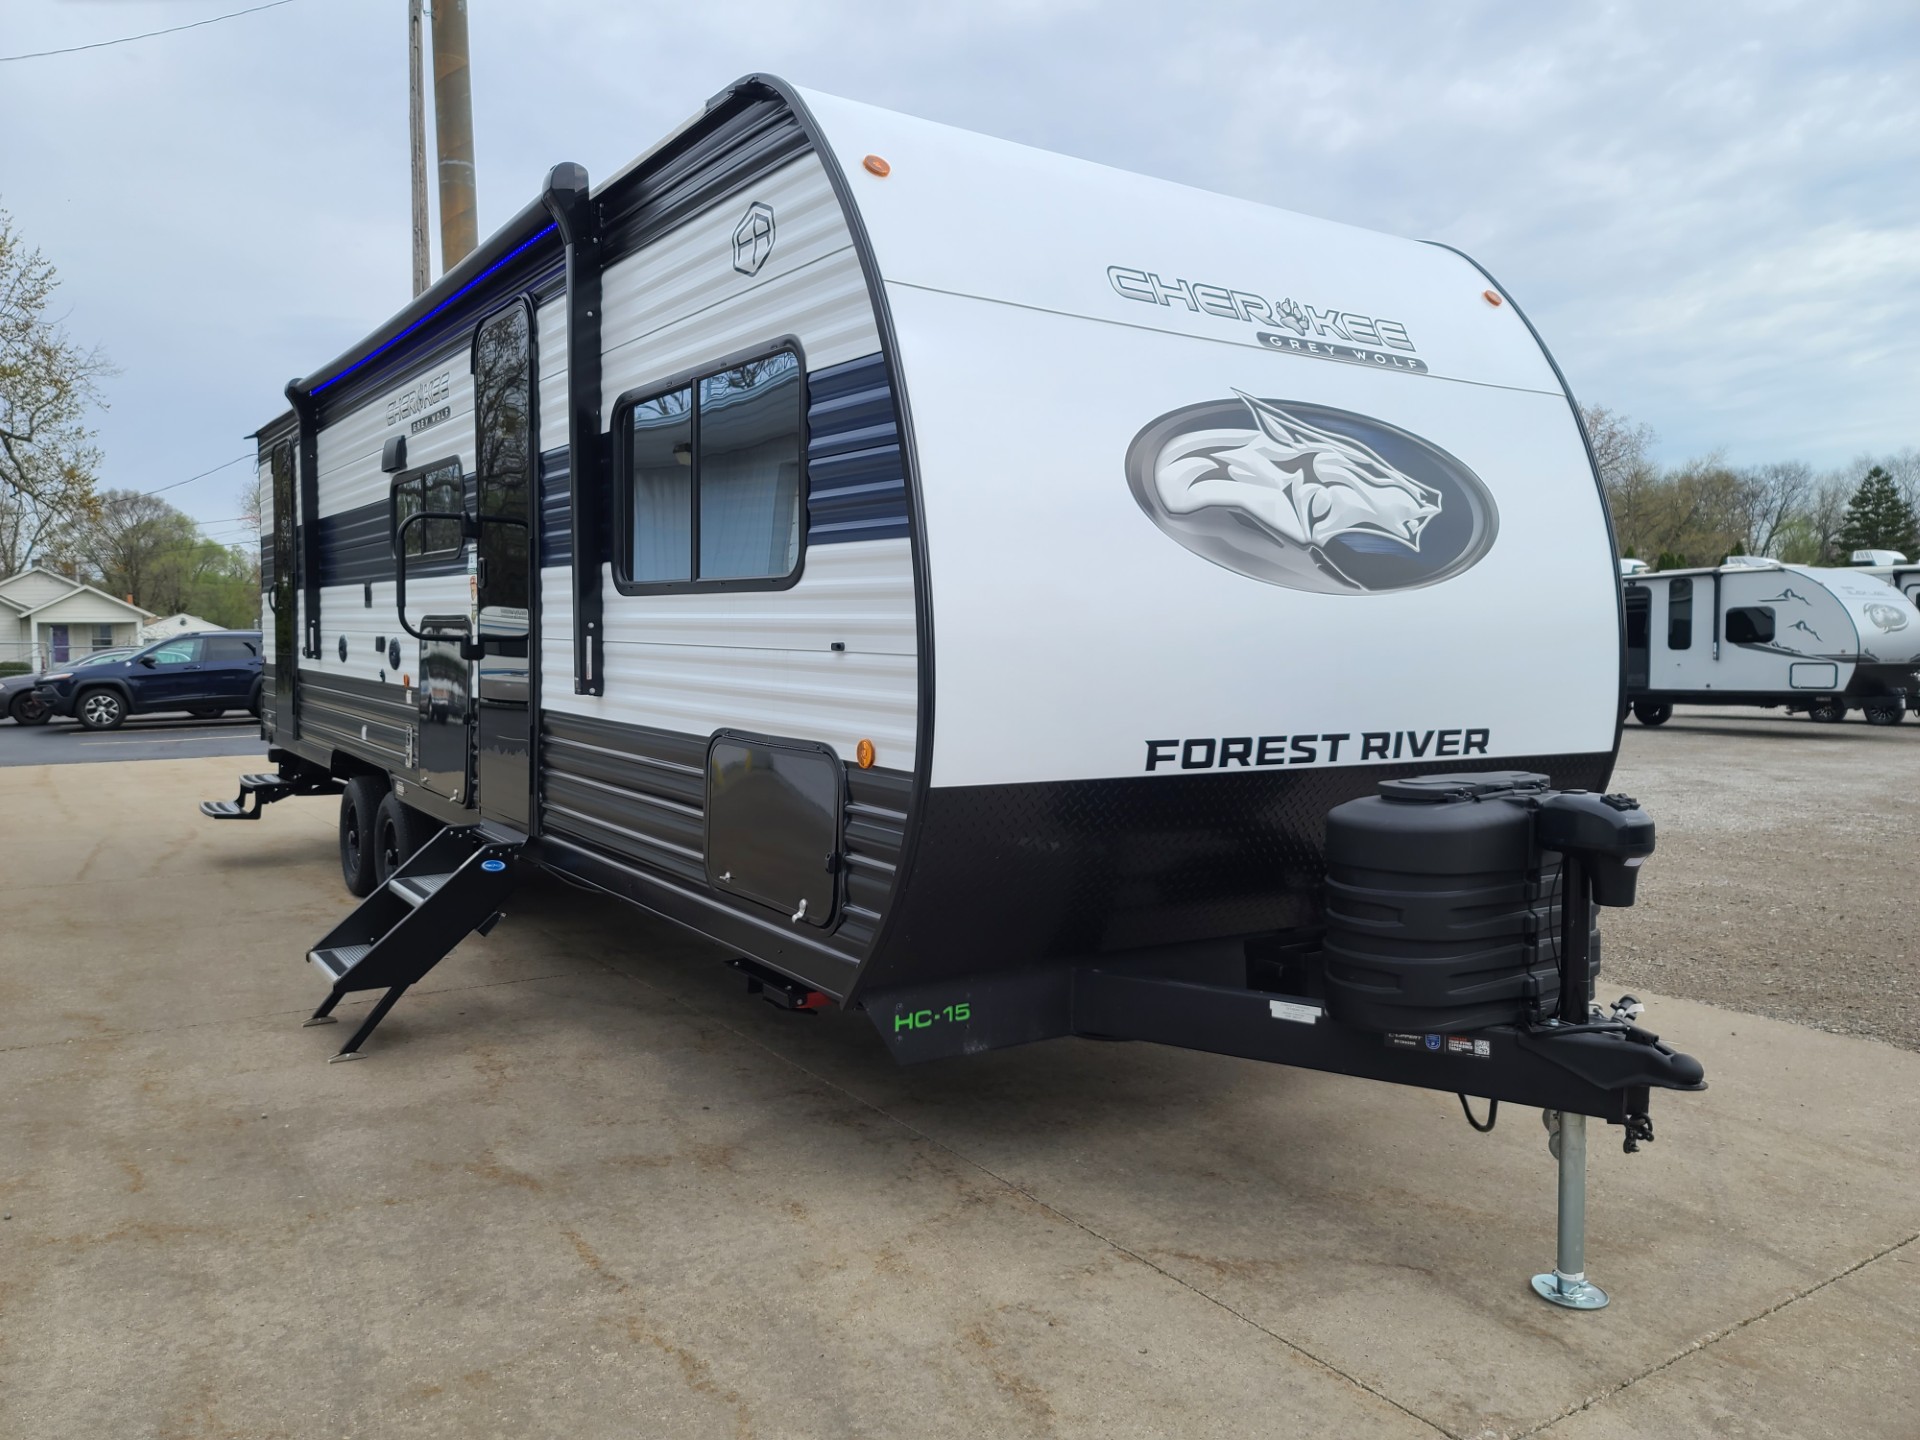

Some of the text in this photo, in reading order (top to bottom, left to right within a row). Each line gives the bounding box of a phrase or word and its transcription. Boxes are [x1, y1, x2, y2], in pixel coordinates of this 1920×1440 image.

[1269, 335, 1418, 370] GREY WOLF
[413, 407, 449, 433] GREY WOLF
[1144, 728, 1490, 772] FOREST RIVER
